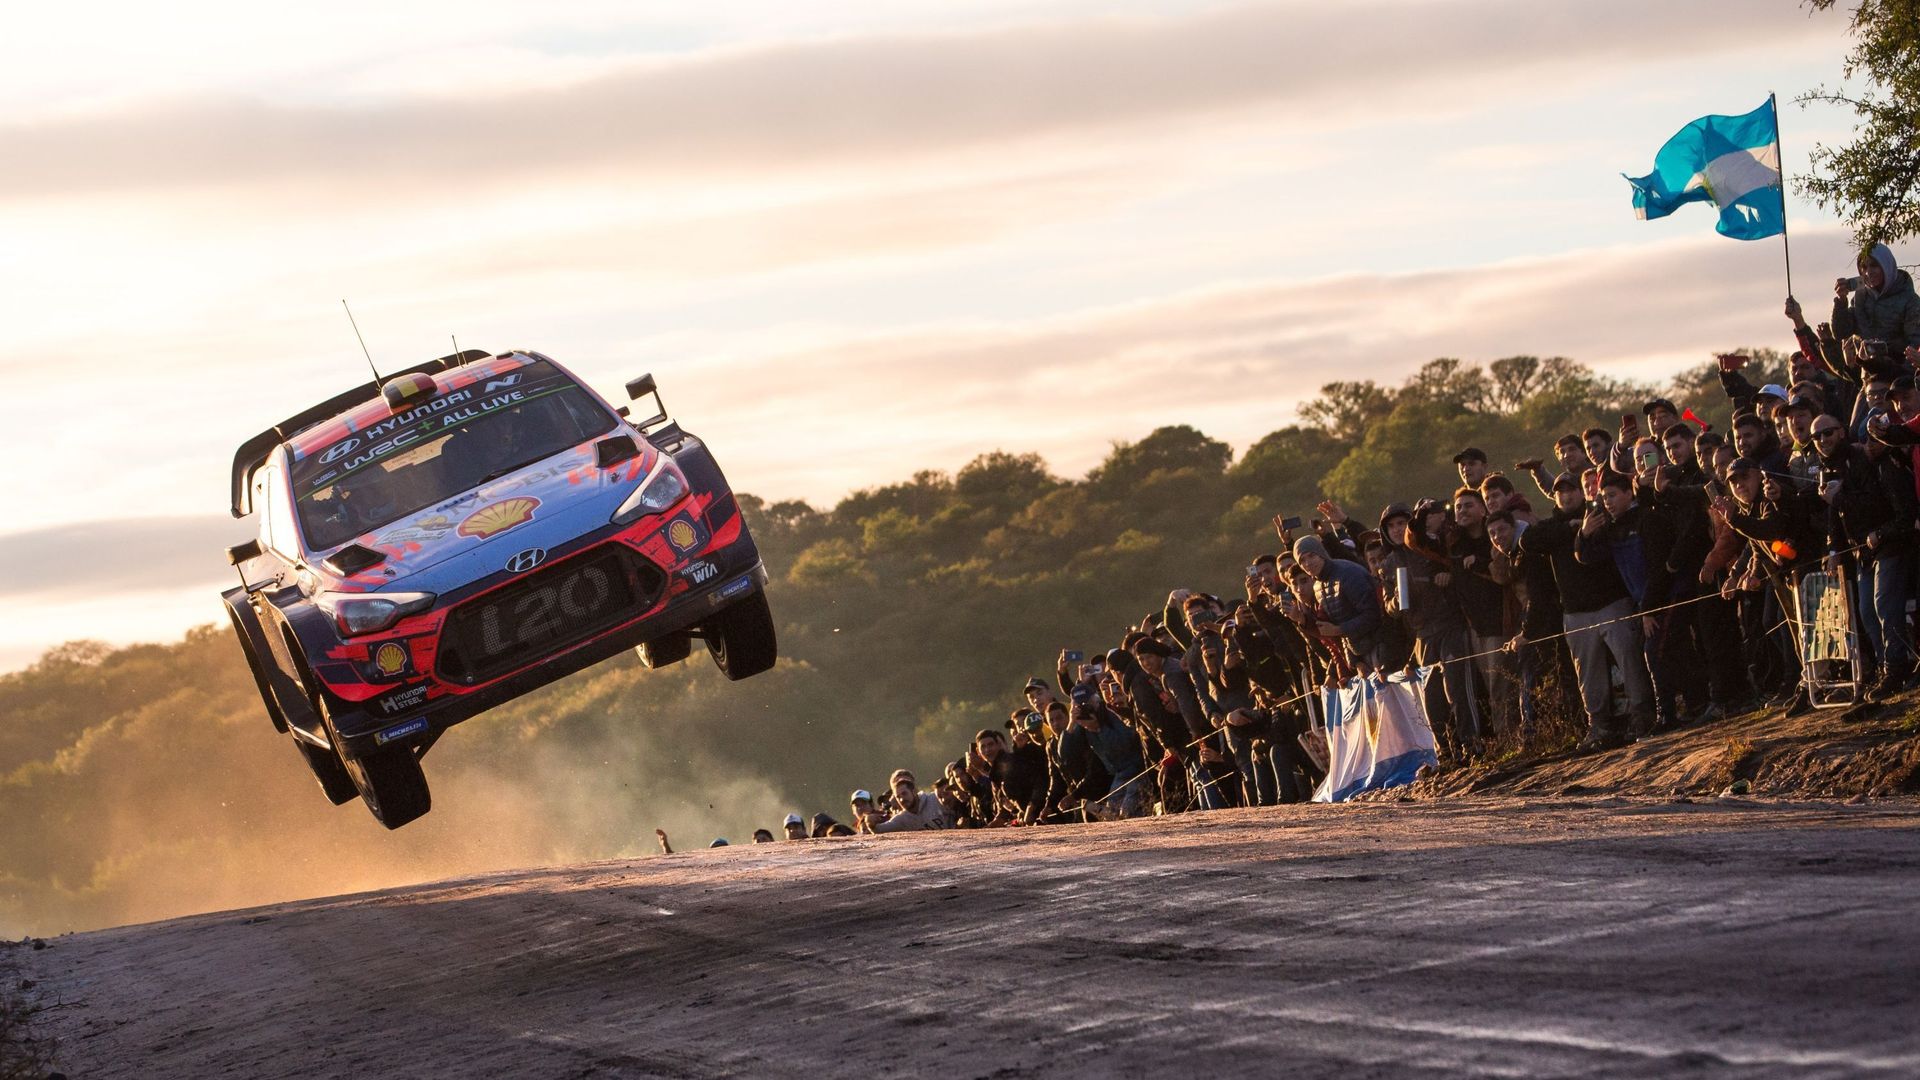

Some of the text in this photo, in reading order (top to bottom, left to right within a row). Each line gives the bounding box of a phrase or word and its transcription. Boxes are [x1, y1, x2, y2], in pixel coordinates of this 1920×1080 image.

[366, 389, 472, 440] HYUNDAI
[443, 407, 479, 426] ALL
[480, 390, 525, 411] LIVE
[681, 560, 706, 576] HYUNDAI
[394, 685, 428, 702] HYUNDAI
[397, 696, 423, 709] STEEL
